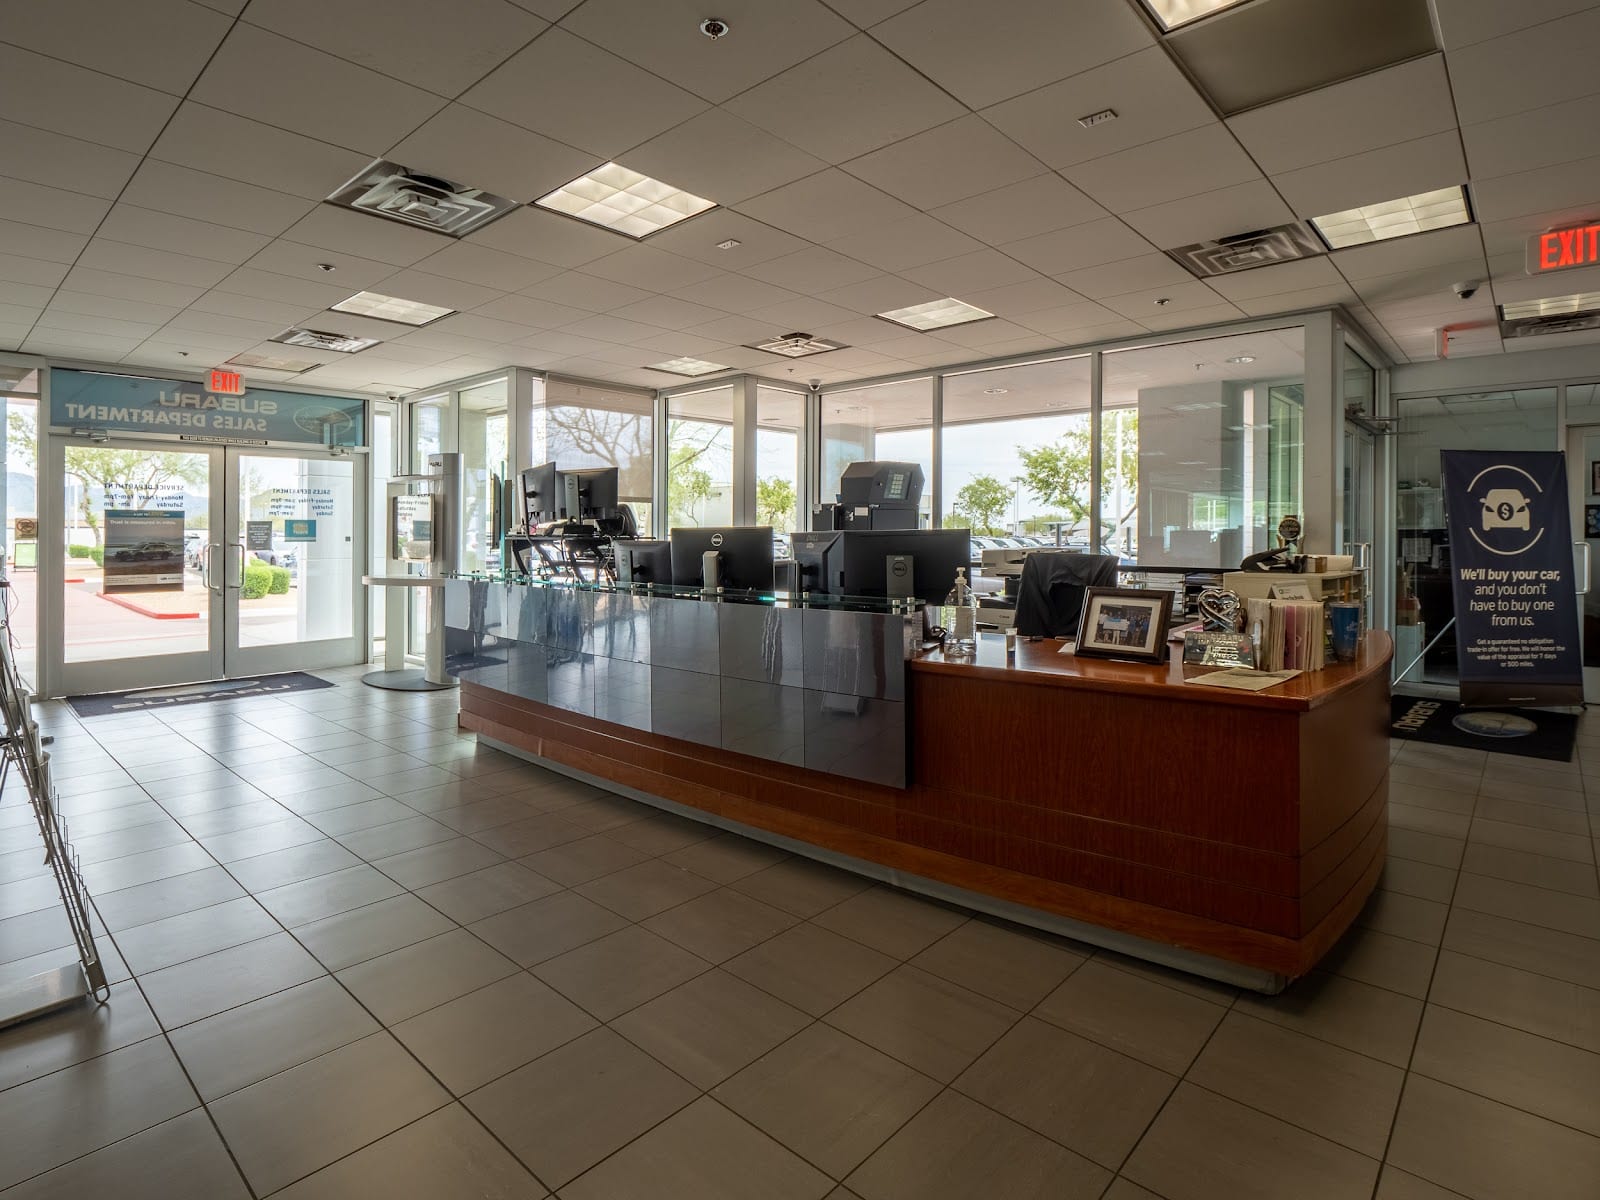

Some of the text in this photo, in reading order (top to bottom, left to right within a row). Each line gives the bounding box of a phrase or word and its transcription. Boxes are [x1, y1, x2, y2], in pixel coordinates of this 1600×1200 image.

[1540, 224, 1600, 270] EXIT
[211, 371, 241, 393] EXIT
[1460, 568, 1561, 582] We'll buy your car,
[1474, 583, 1547, 598] and you don't
[1469, 599, 1555, 613] have to buy one
[1491, 614, 1535, 627] from us.
[1491, 638, 1520, 646] guaranteed
[1529, 638, 1554, 646] obligation
[1507, 653, 1531, 661] appraisal
[1544, 653, 1558, 661] days
[112, 685, 290, 709] SUBARU
[1392, 700, 1441, 731] SUBARU
